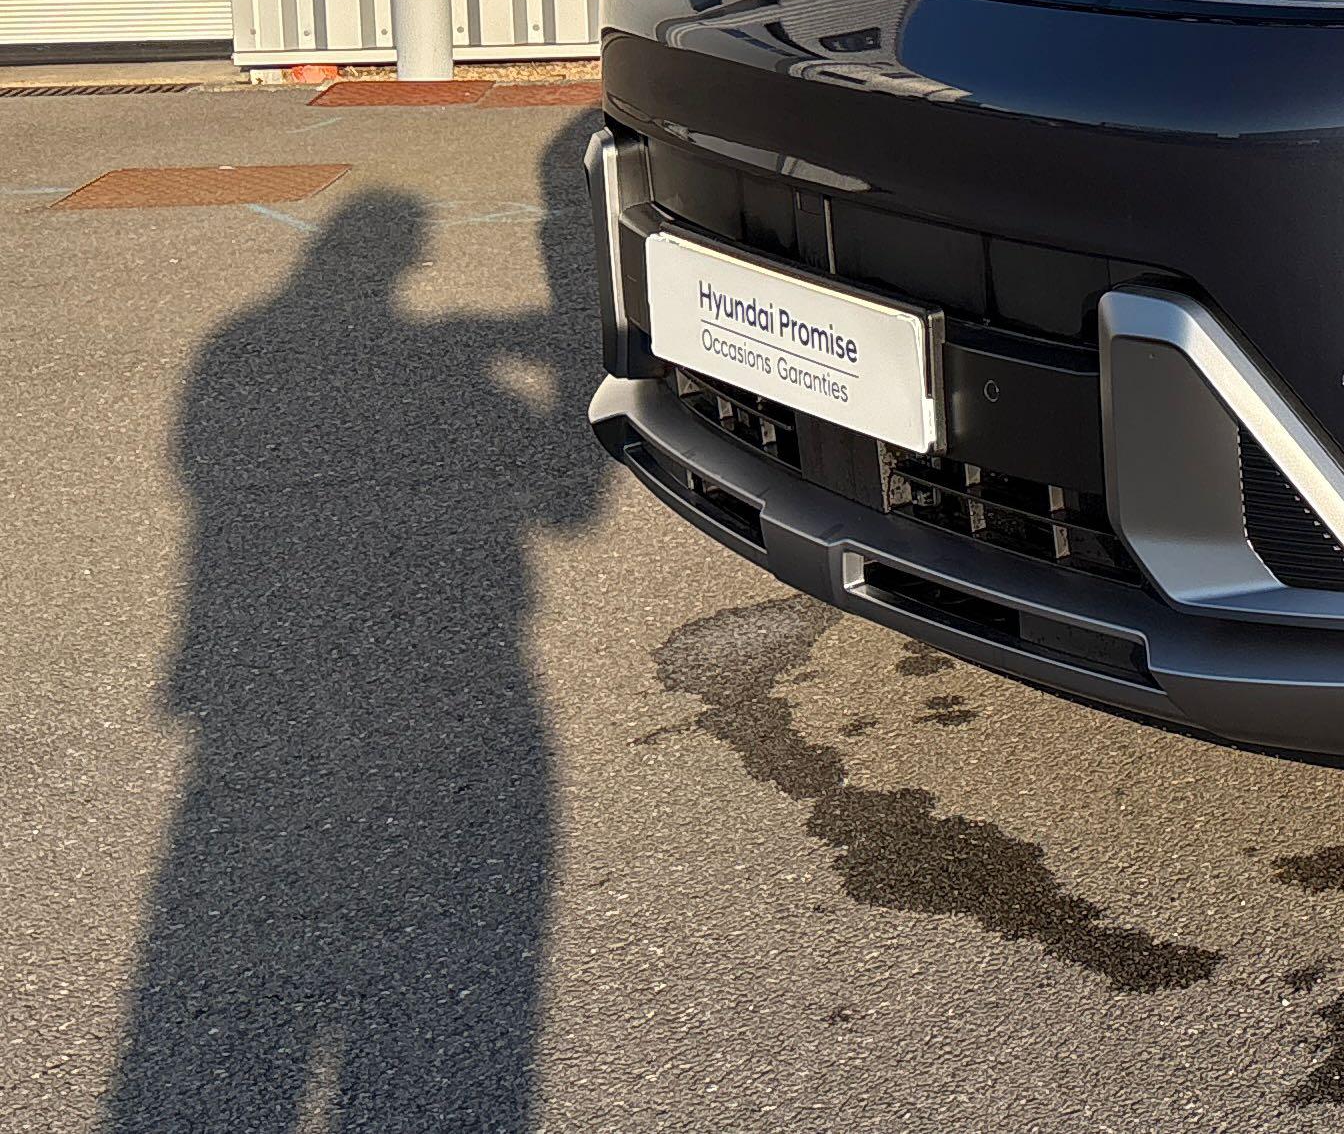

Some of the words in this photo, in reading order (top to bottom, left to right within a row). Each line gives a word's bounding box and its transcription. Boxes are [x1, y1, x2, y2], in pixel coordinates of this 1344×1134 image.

[699, 280, 774, 334] Hyundai
[779, 309, 858, 363] Promise
[702, 328, 772, 374] Occasions
[777, 356, 849, 403] Garanties
